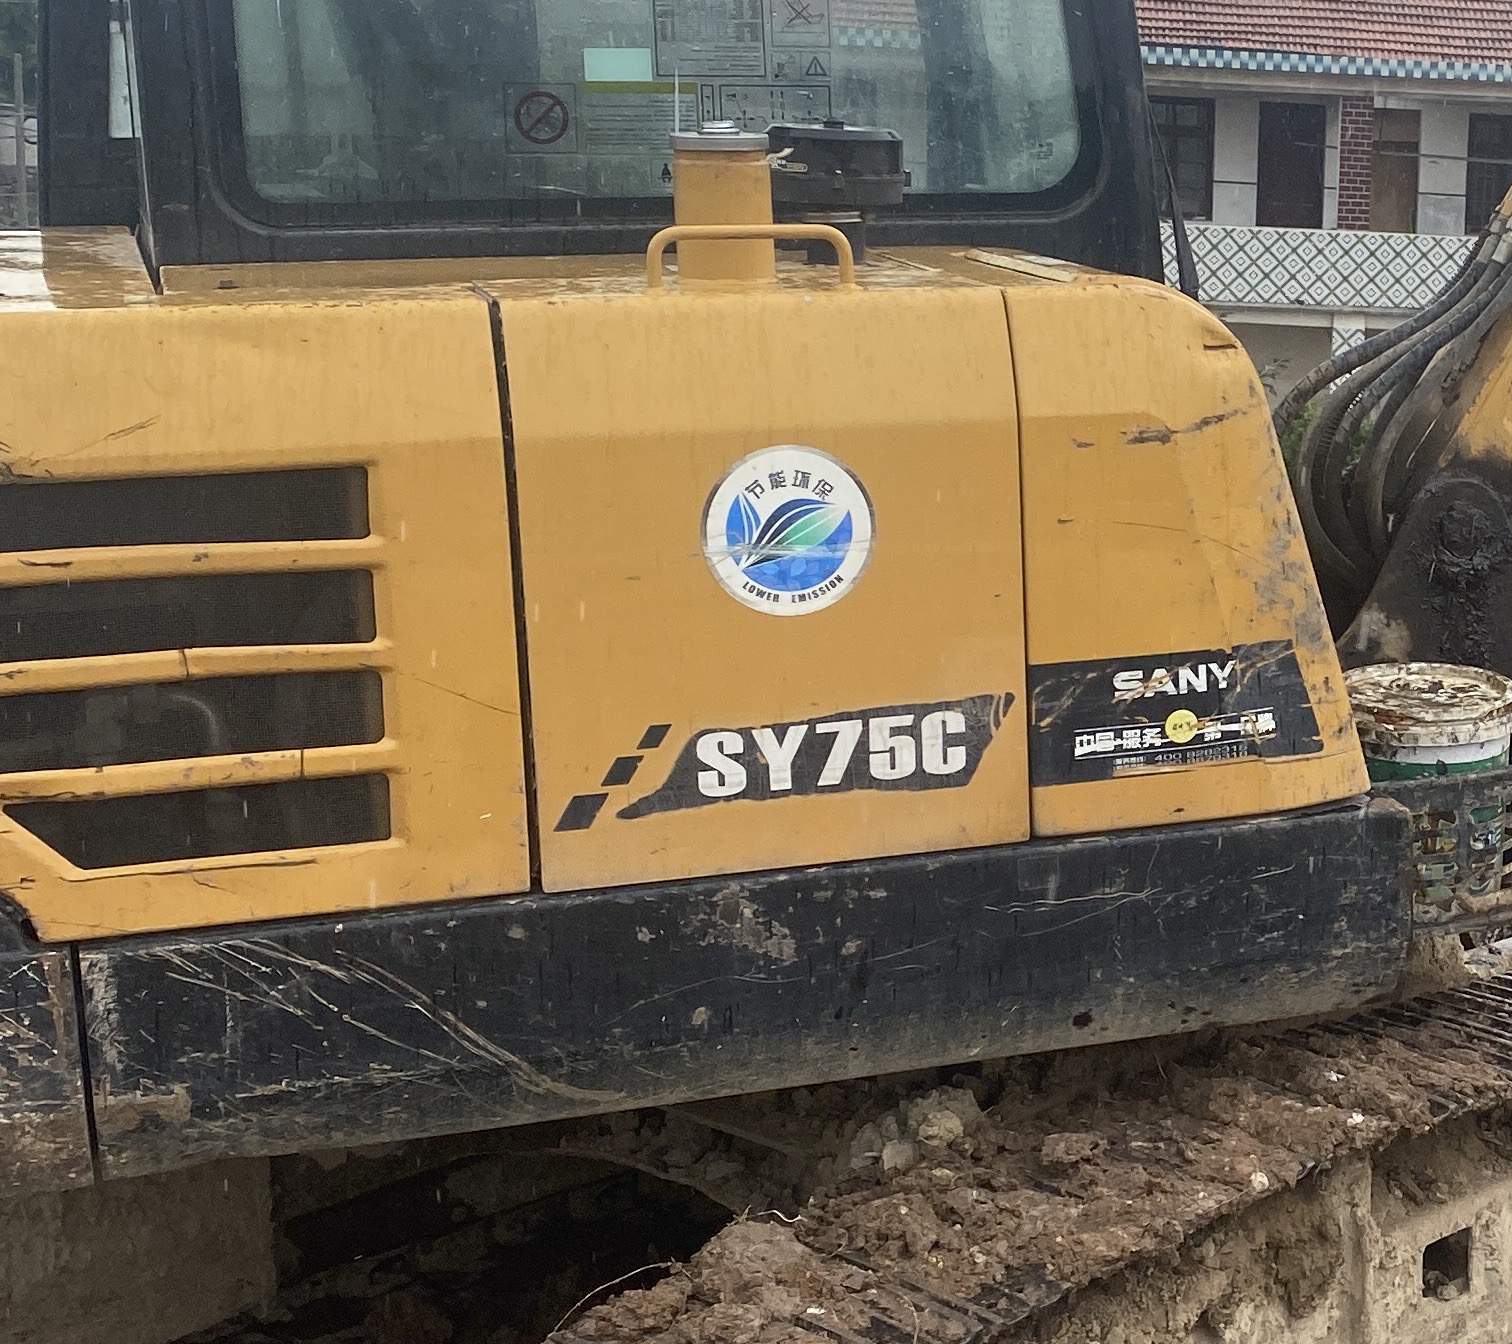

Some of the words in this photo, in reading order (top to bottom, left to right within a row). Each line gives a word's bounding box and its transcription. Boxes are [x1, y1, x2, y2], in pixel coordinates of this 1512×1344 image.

[742, 581, 780, 602] LOWER
[791, 574, 844, 603] EMISSION
[1112, 659, 1237, 700] SANY
[696, 710, 967, 798] SY75C
